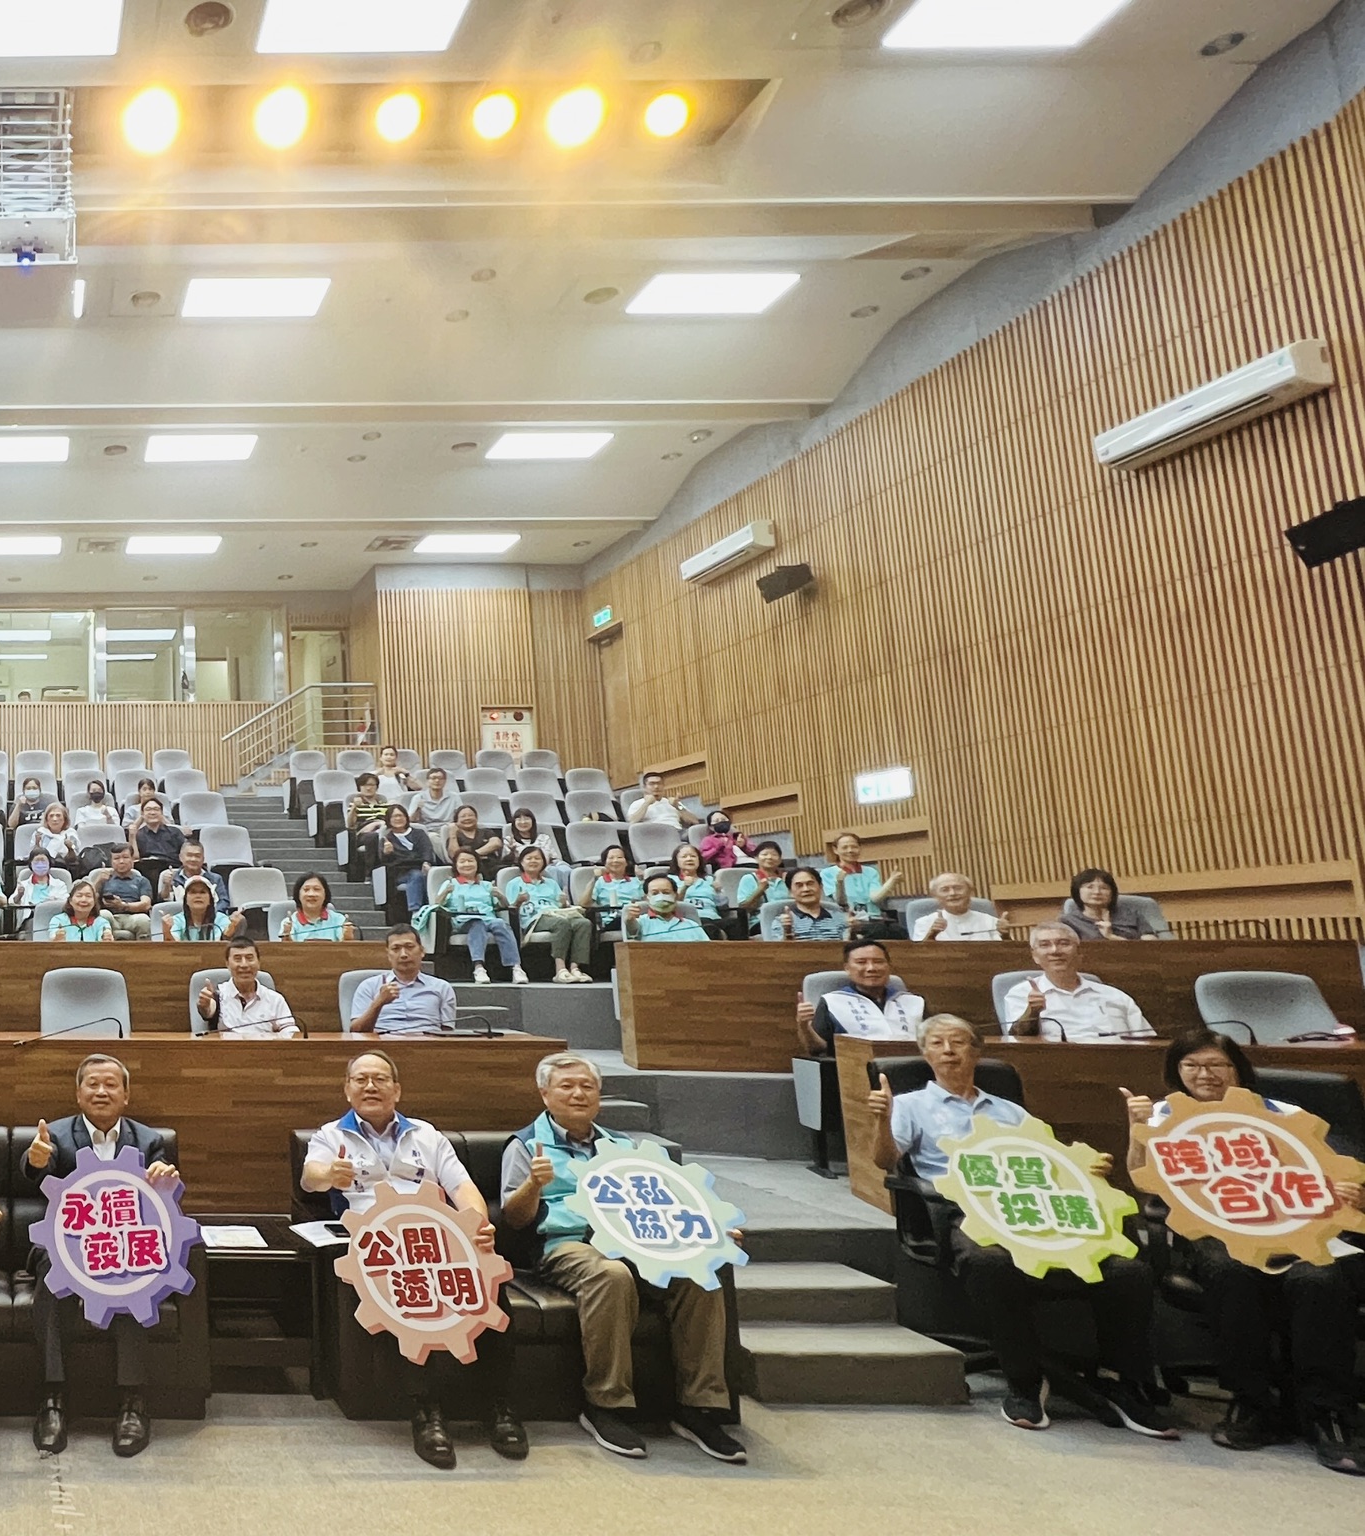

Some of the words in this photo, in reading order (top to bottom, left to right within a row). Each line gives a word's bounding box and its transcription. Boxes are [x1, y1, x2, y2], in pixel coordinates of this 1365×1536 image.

[957, 1152, 1053, 1192] 優質
[1154, 1132, 1275, 1177] 跨域
[61, 1187, 139, 1231] 永續
[586, 1174, 672, 1206] 公私
[1208, 1172, 1327, 1217] 合作
[624, 1208, 713, 1241] 協力
[997, 1190, 1100, 1232] 採購
[84, 1228, 165, 1272] 發展
[357, 1227, 442, 1267] 公開
[392, 1267, 479, 1308] 透明
